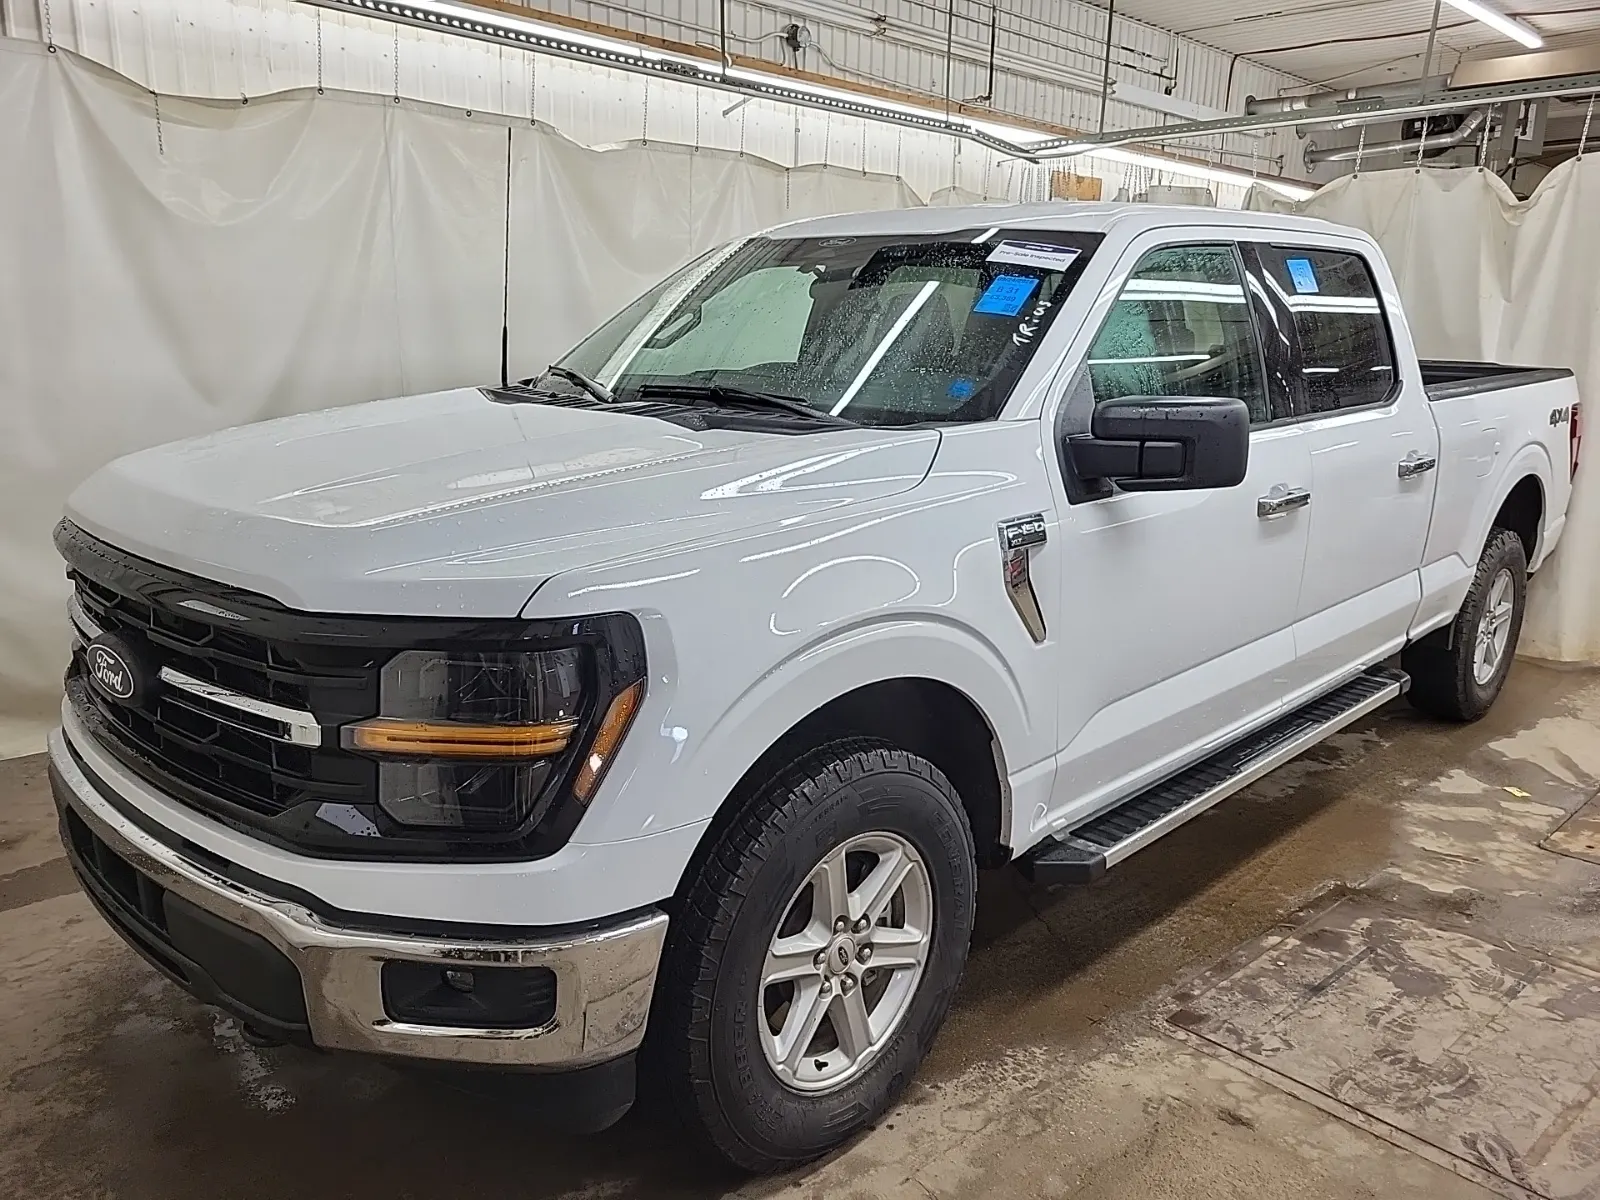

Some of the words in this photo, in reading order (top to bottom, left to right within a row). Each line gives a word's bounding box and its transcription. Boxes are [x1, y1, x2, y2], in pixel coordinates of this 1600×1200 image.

[1030, 254, 1066, 263] Inspected
[1007, 521, 1044, 538] F-150
[95, 650, 123, 692] Ford
[928, 811, 966, 938] GENERAL
